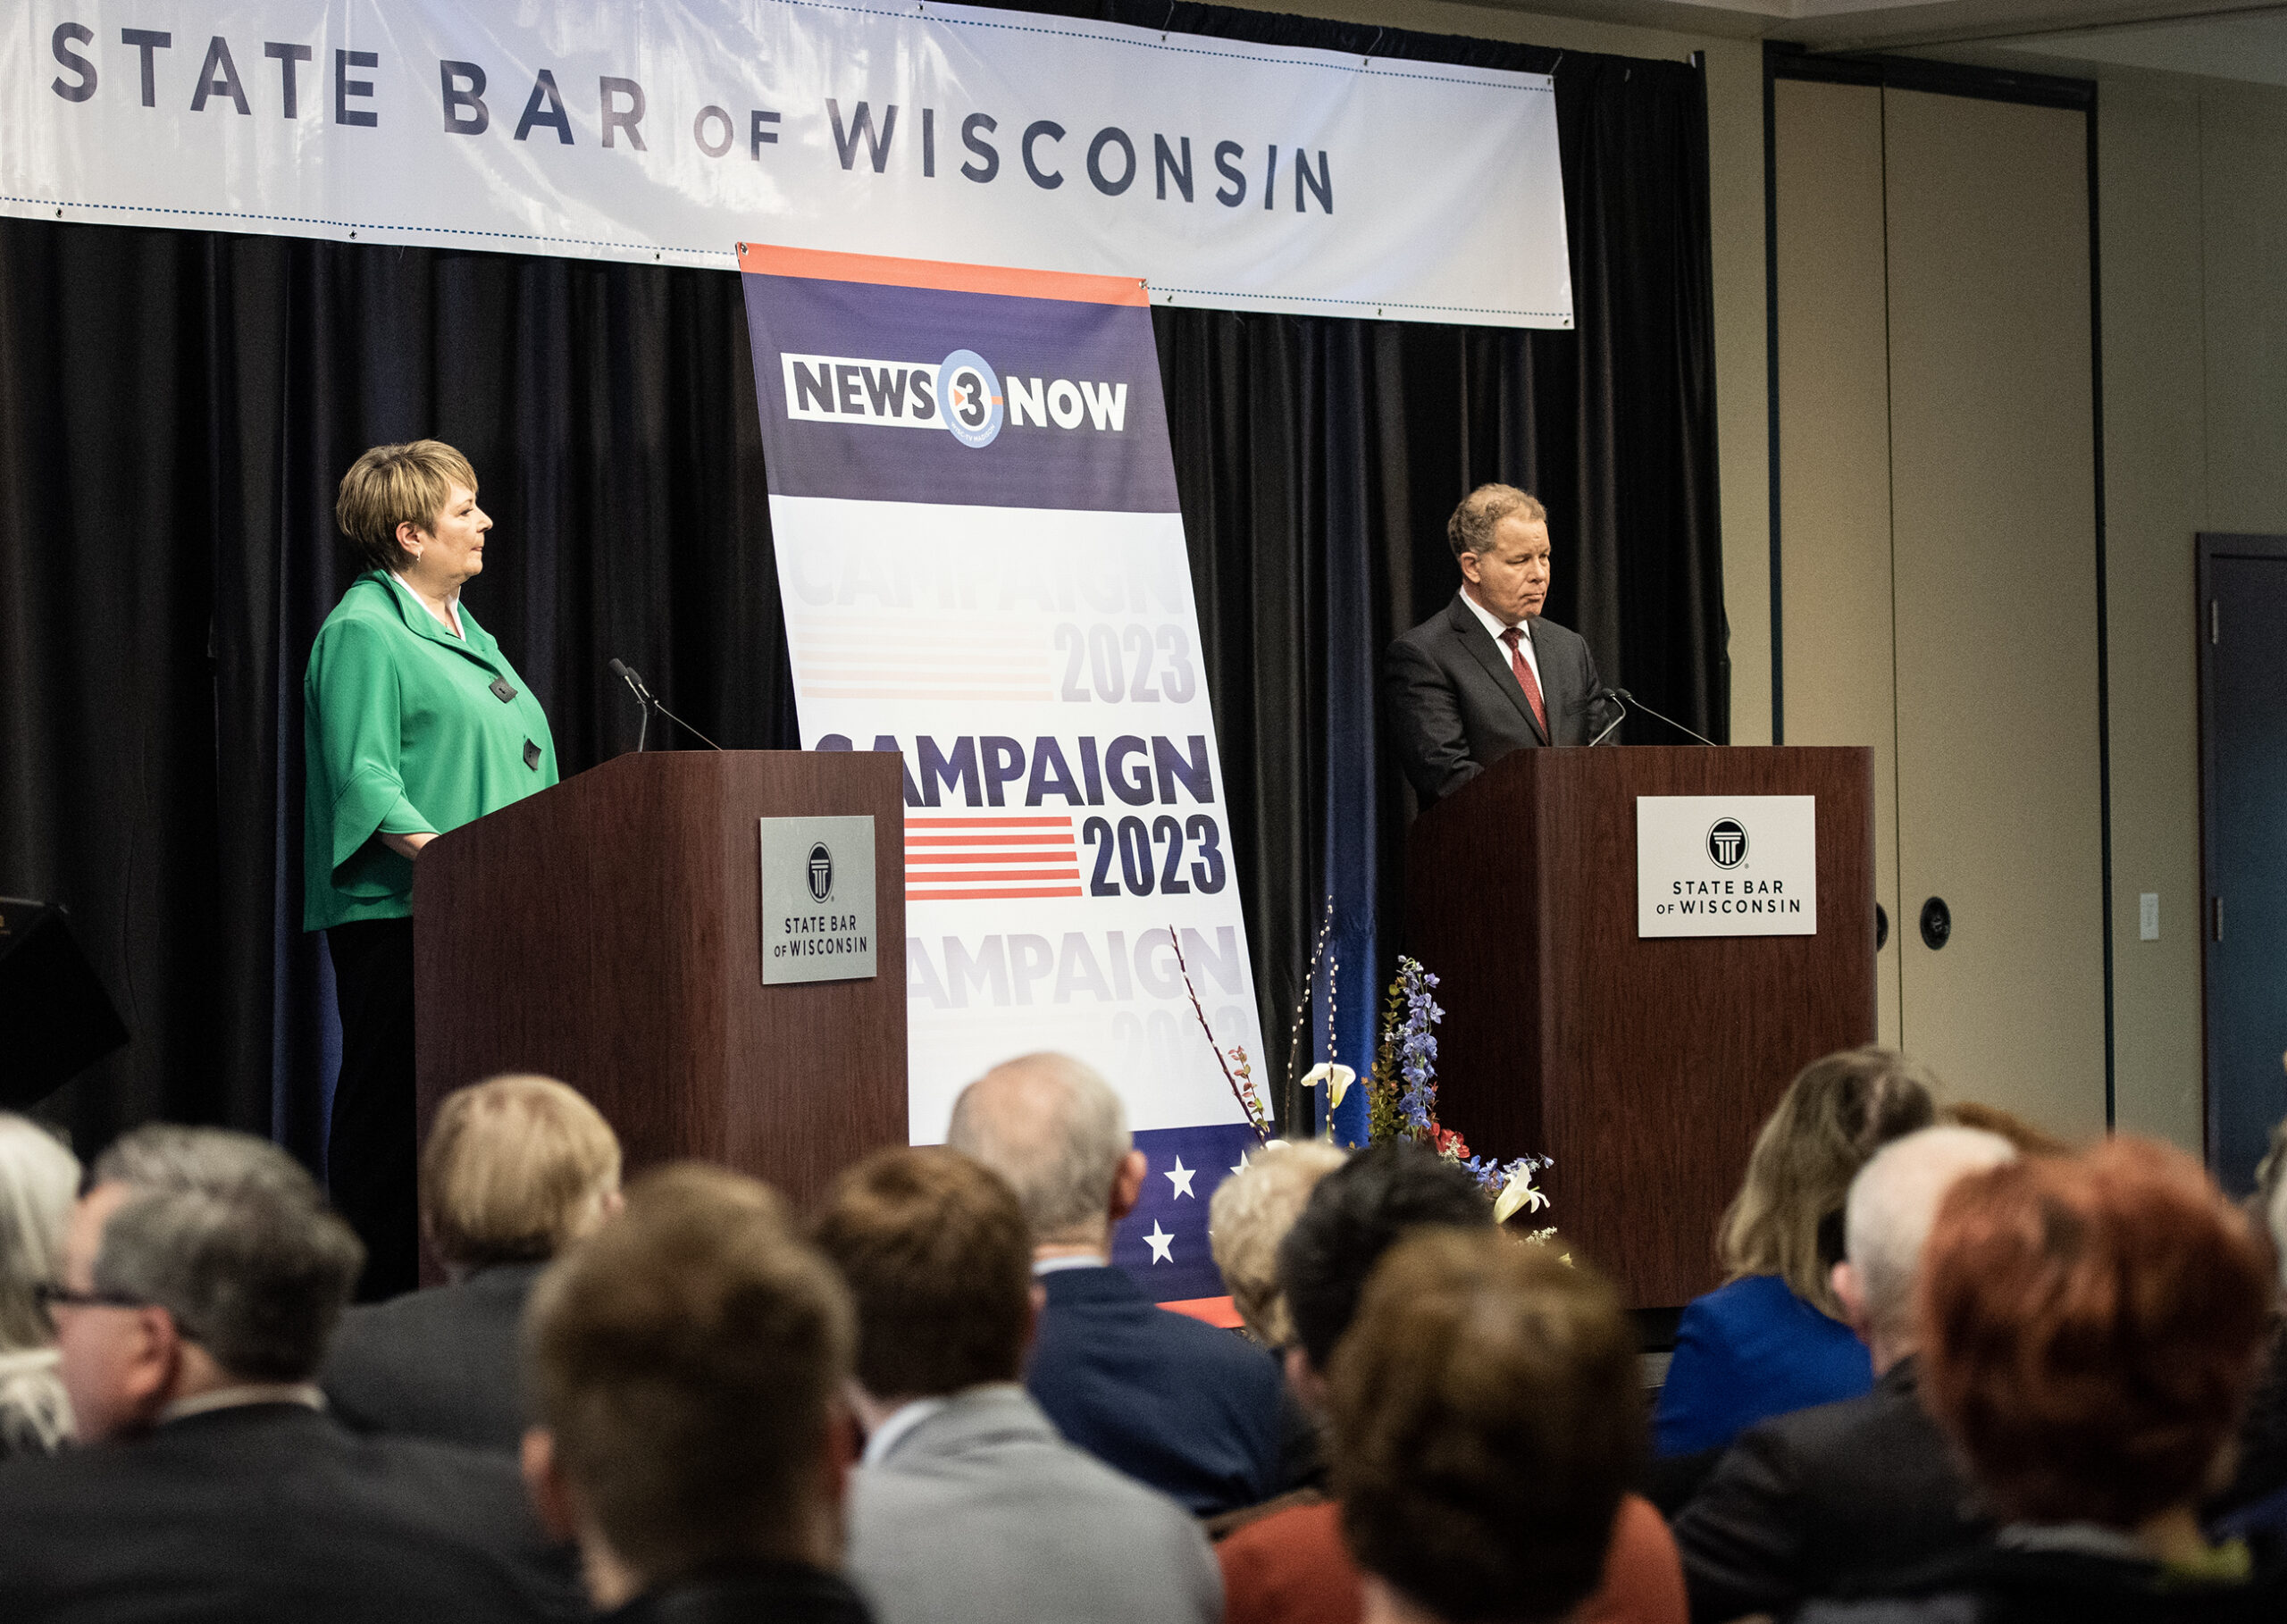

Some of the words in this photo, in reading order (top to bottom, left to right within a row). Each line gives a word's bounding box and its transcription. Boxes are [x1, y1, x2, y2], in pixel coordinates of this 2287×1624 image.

[51, 21, 379, 128] STATE
[439, 59, 649, 153] BAR
[692, 104, 782, 162] OF
[825, 97, 1335, 215] WISCONSIN
[792, 360, 936, 420] NEWS
[956, 372, 985, 427] 3
[1005, 375, 1128, 432] NOW
[788, 534, 1185, 615] CAMPAIGN
[1053, 622, 1197, 705] 2023
[1082, 814, 1227, 898] 2023
[1672, 881, 1734, 895] STATE
[1744, 880, 1783, 894] BAR
[785, 916, 825, 934] STATE
[831, 915, 857, 932] BAR
[1656, 904, 1675, 915] OF
[1680, 899, 1801, 915] WISCONSIN
[774, 945, 787, 958] OF
[790, 936, 867, 957] WISCONSIN
[906, 925, 1244, 1009] AMPAIGN
